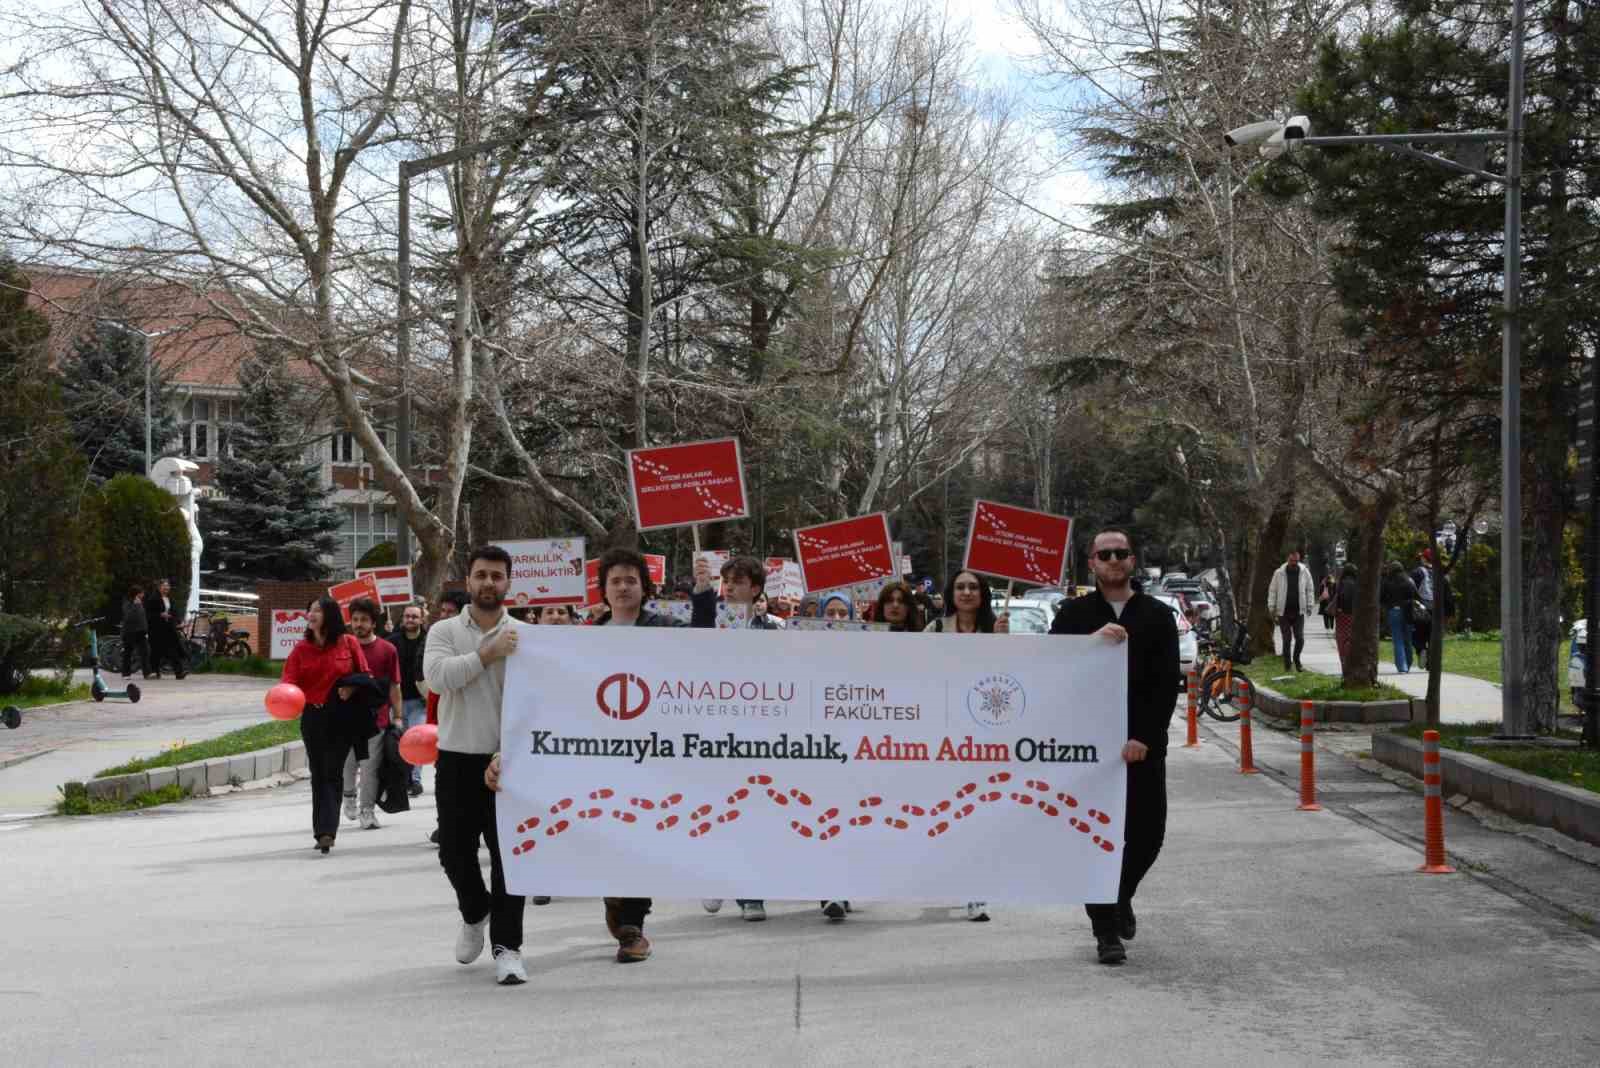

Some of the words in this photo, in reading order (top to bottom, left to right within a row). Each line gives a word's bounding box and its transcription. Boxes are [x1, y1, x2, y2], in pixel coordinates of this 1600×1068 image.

[656, 680, 795, 701] ANADOLU
[824, 684, 886, 701] EĞİTİM
[660, 702, 789, 717] ÜNİVERSİTESİ
[824, 704, 921, 721] FAKÜLTESİ
[531, 731, 676, 764] Kırmızıyla
[682, 733, 848, 764] Farkındalık,
[854, 735, 930, 761] Adım
[936, 736, 1011, 762] Adım
[1015, 738, 1099, 763] Otizm
